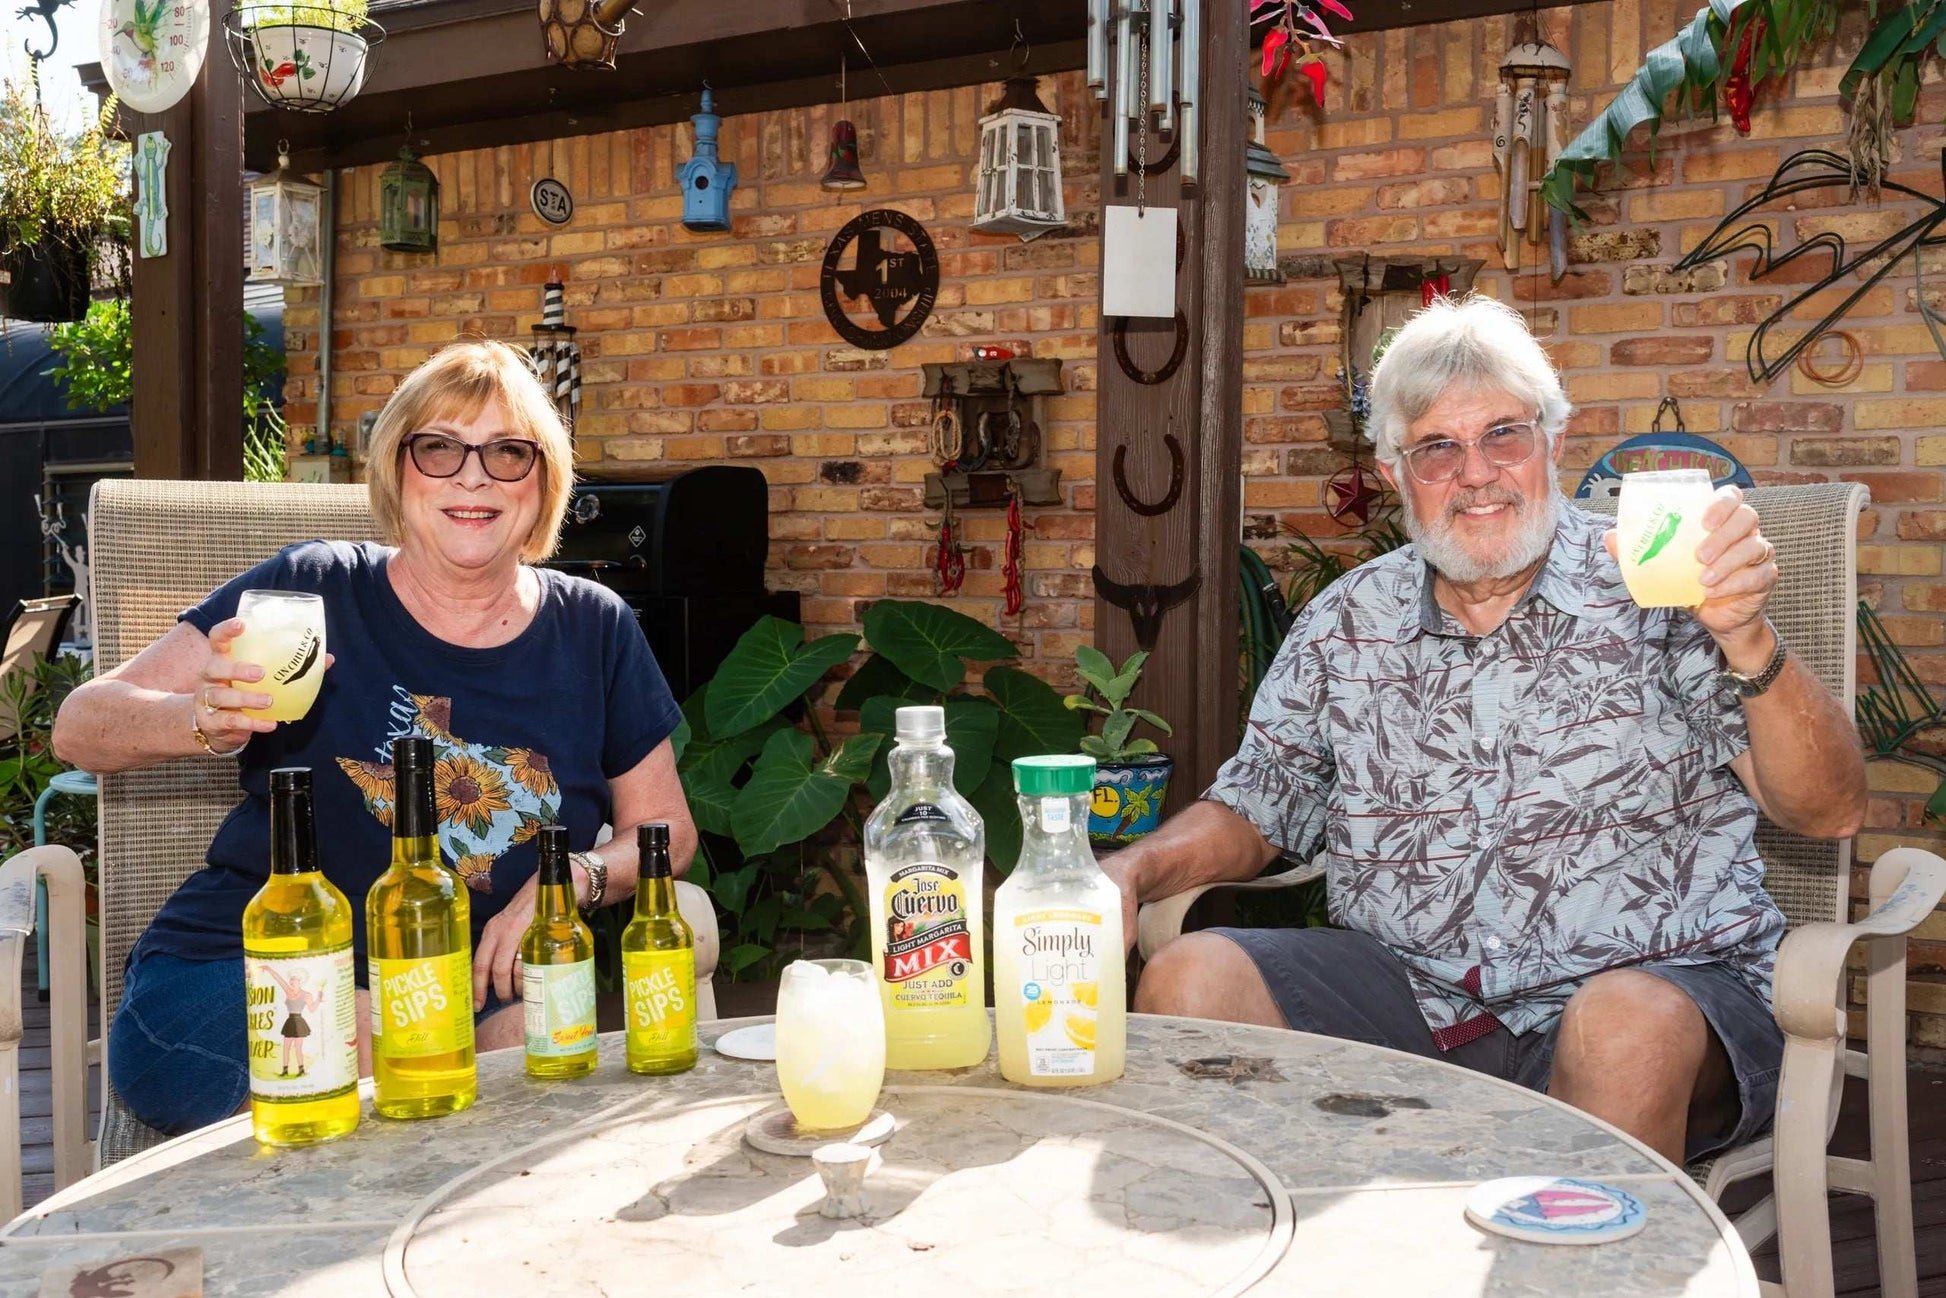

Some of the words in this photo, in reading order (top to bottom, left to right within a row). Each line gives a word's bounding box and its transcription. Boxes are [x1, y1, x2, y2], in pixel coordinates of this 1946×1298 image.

[174, 6, 185, 17] 80
[169, 34, 184, 46] 100
[160, 61, 175, 72] 120
[874, 288, 908, 300] 2004
[1093, 788, 1119, 805] FL.
[898, 865, 936, 878] MARGARITA
[936, 867, 950, 876] MIX
[911, 878, 939, 896] Jose
[891, 889, 959, 920] Cuervo
[892, 941, 918, 953] LIGHT
[916, 924, 963, 945] MARGARITA
[1022, 926, 1095, 958] Simply
[893, 938, 961, 977] MIX
[383, 961, 438, 998] PICKLE
[628, 966, 677, 999] PICKLE
[1031, 957, 1089, 987] Light
[902, 980, 928, 990] JUST
[931, 979, 954, 988] ADD
[390, 983, 448, 1028] SIPS
[634, 986, 685, 1027] SIPS
[895, 994, 928, 1002] CUERVO
[929, 992, 964, 1001] TEQUILA
